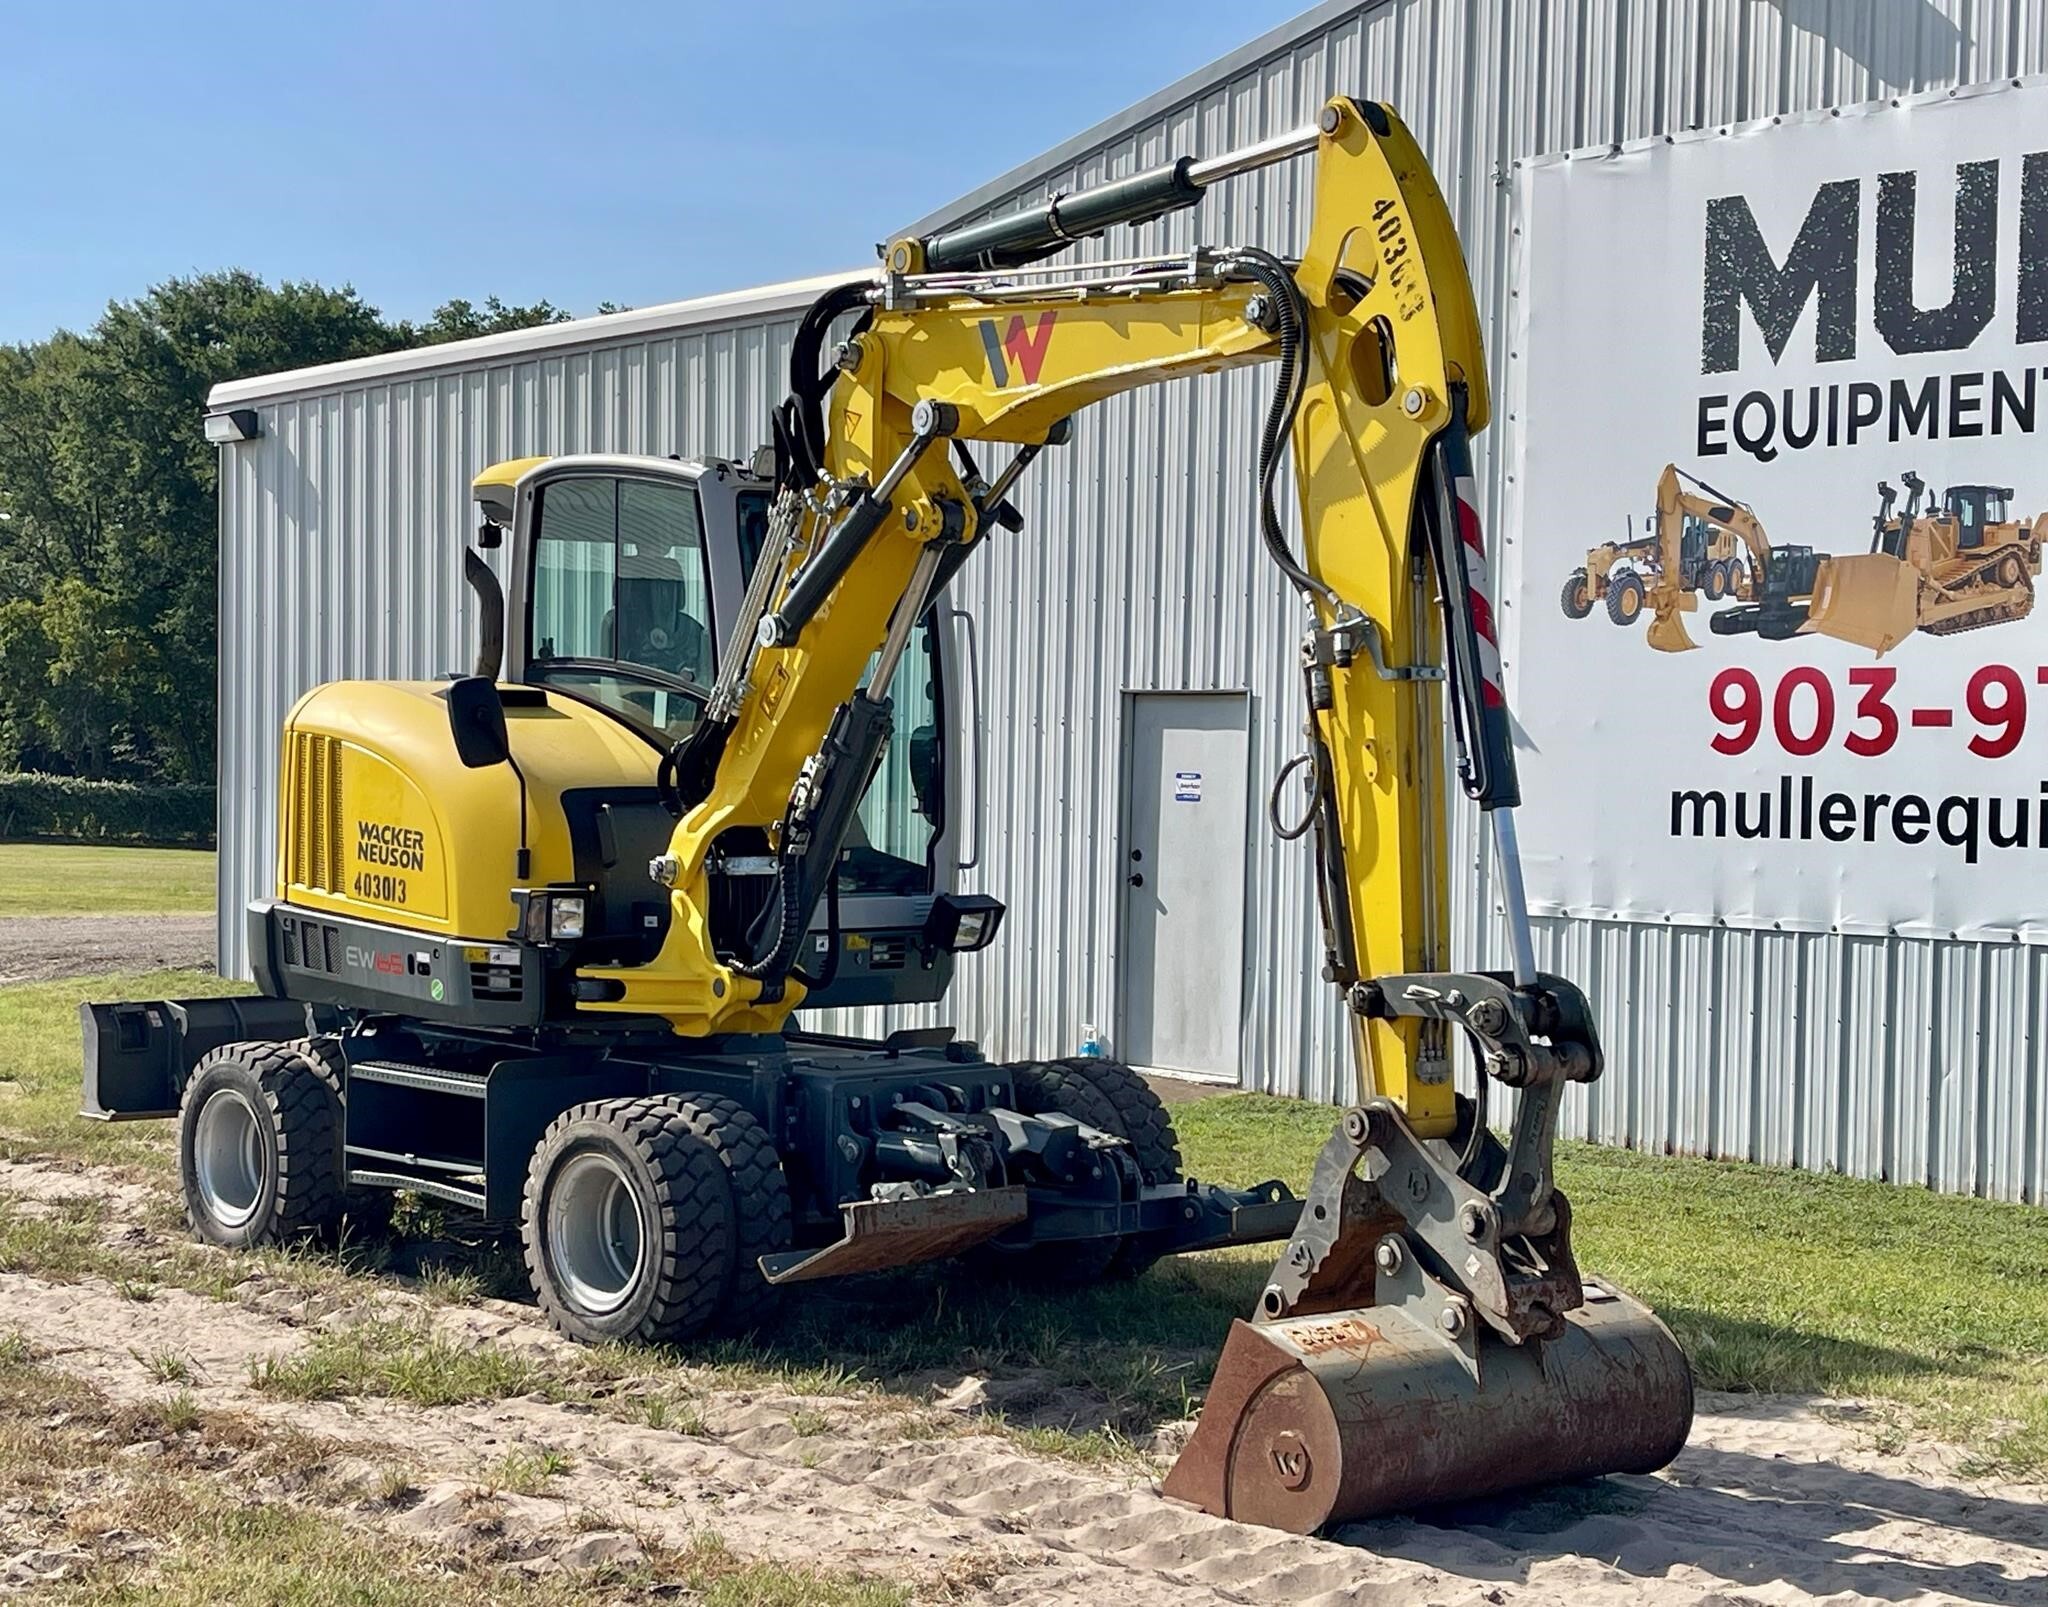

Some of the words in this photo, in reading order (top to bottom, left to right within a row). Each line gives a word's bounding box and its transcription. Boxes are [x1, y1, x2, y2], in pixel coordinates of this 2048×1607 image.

[1697, 362, 2048, 463] EQUIPMEN
[1708, 664, 2048, 759] 903-9
[358, 820, 424, 851] WACKER
[357, 841, 424, 872] NEUSON
[354, 871, 406, 904] 403013
